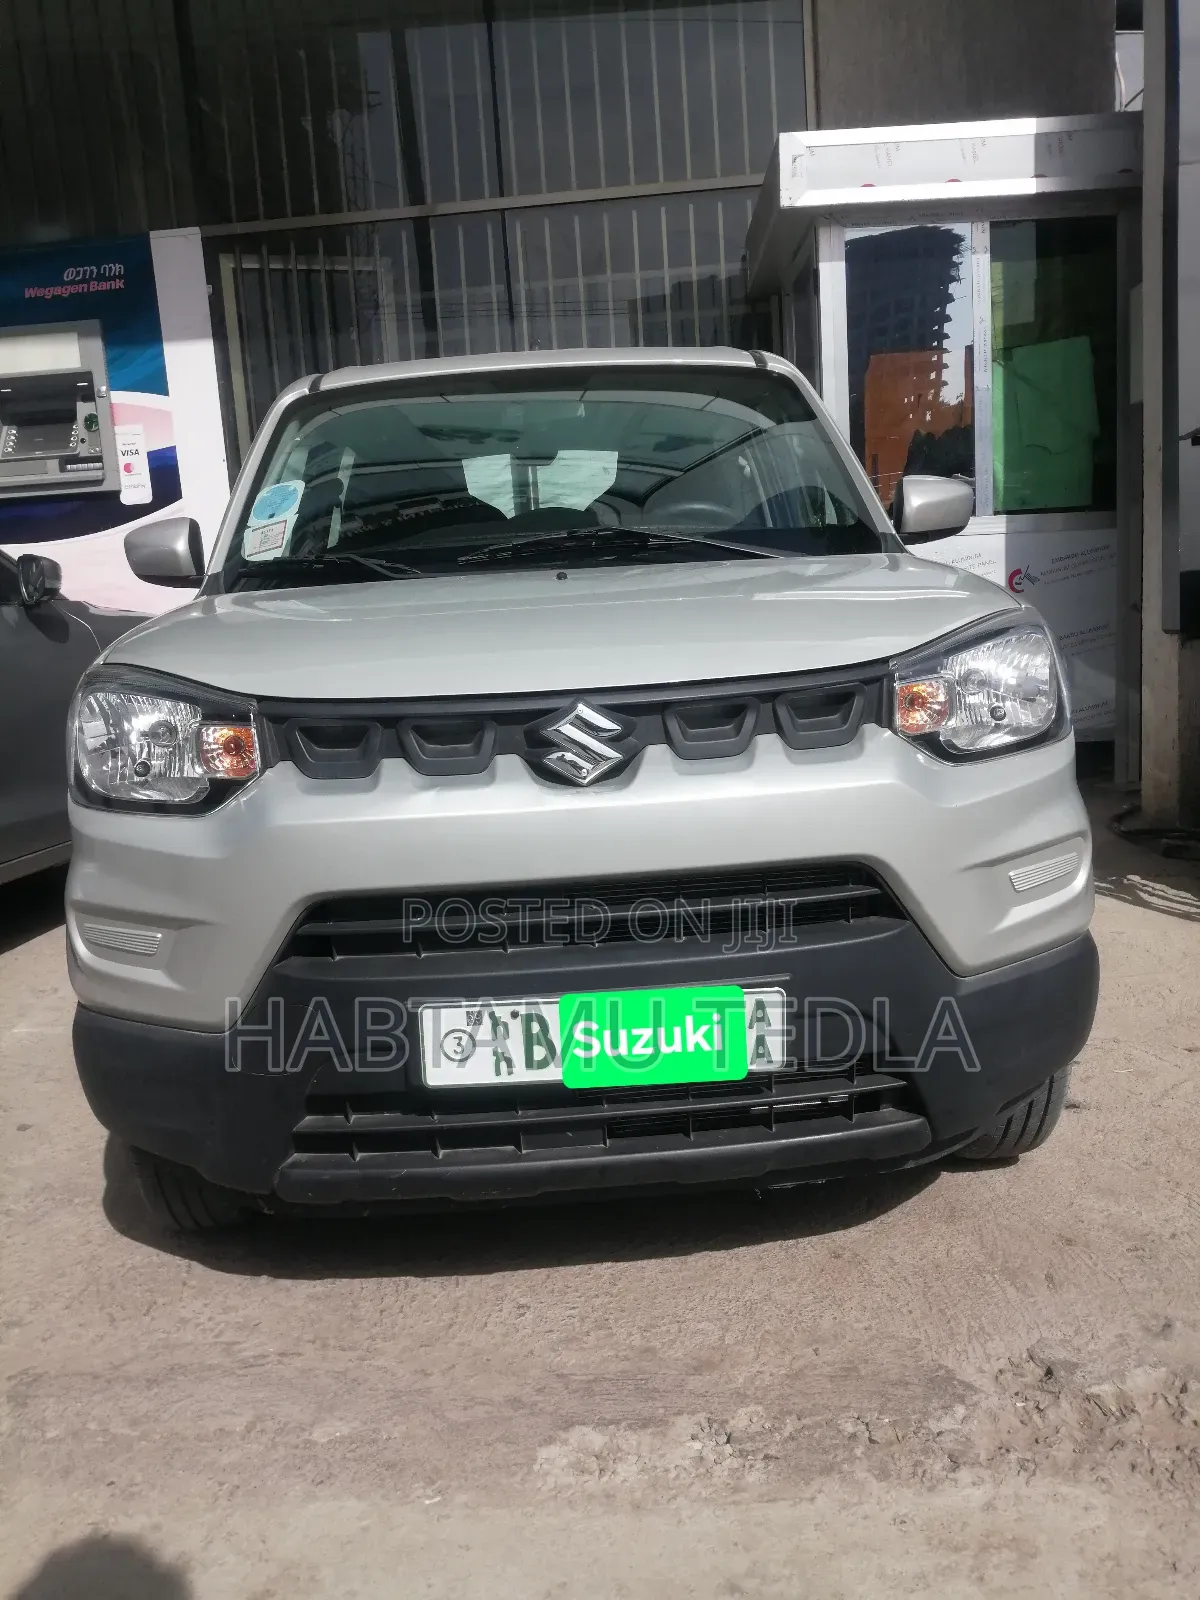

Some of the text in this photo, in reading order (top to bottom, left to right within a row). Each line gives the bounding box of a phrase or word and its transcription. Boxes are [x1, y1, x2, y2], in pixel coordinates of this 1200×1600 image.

[24, 278, 125, 299] Wegagen Bank
[120, 448, 140, 457] VISA
